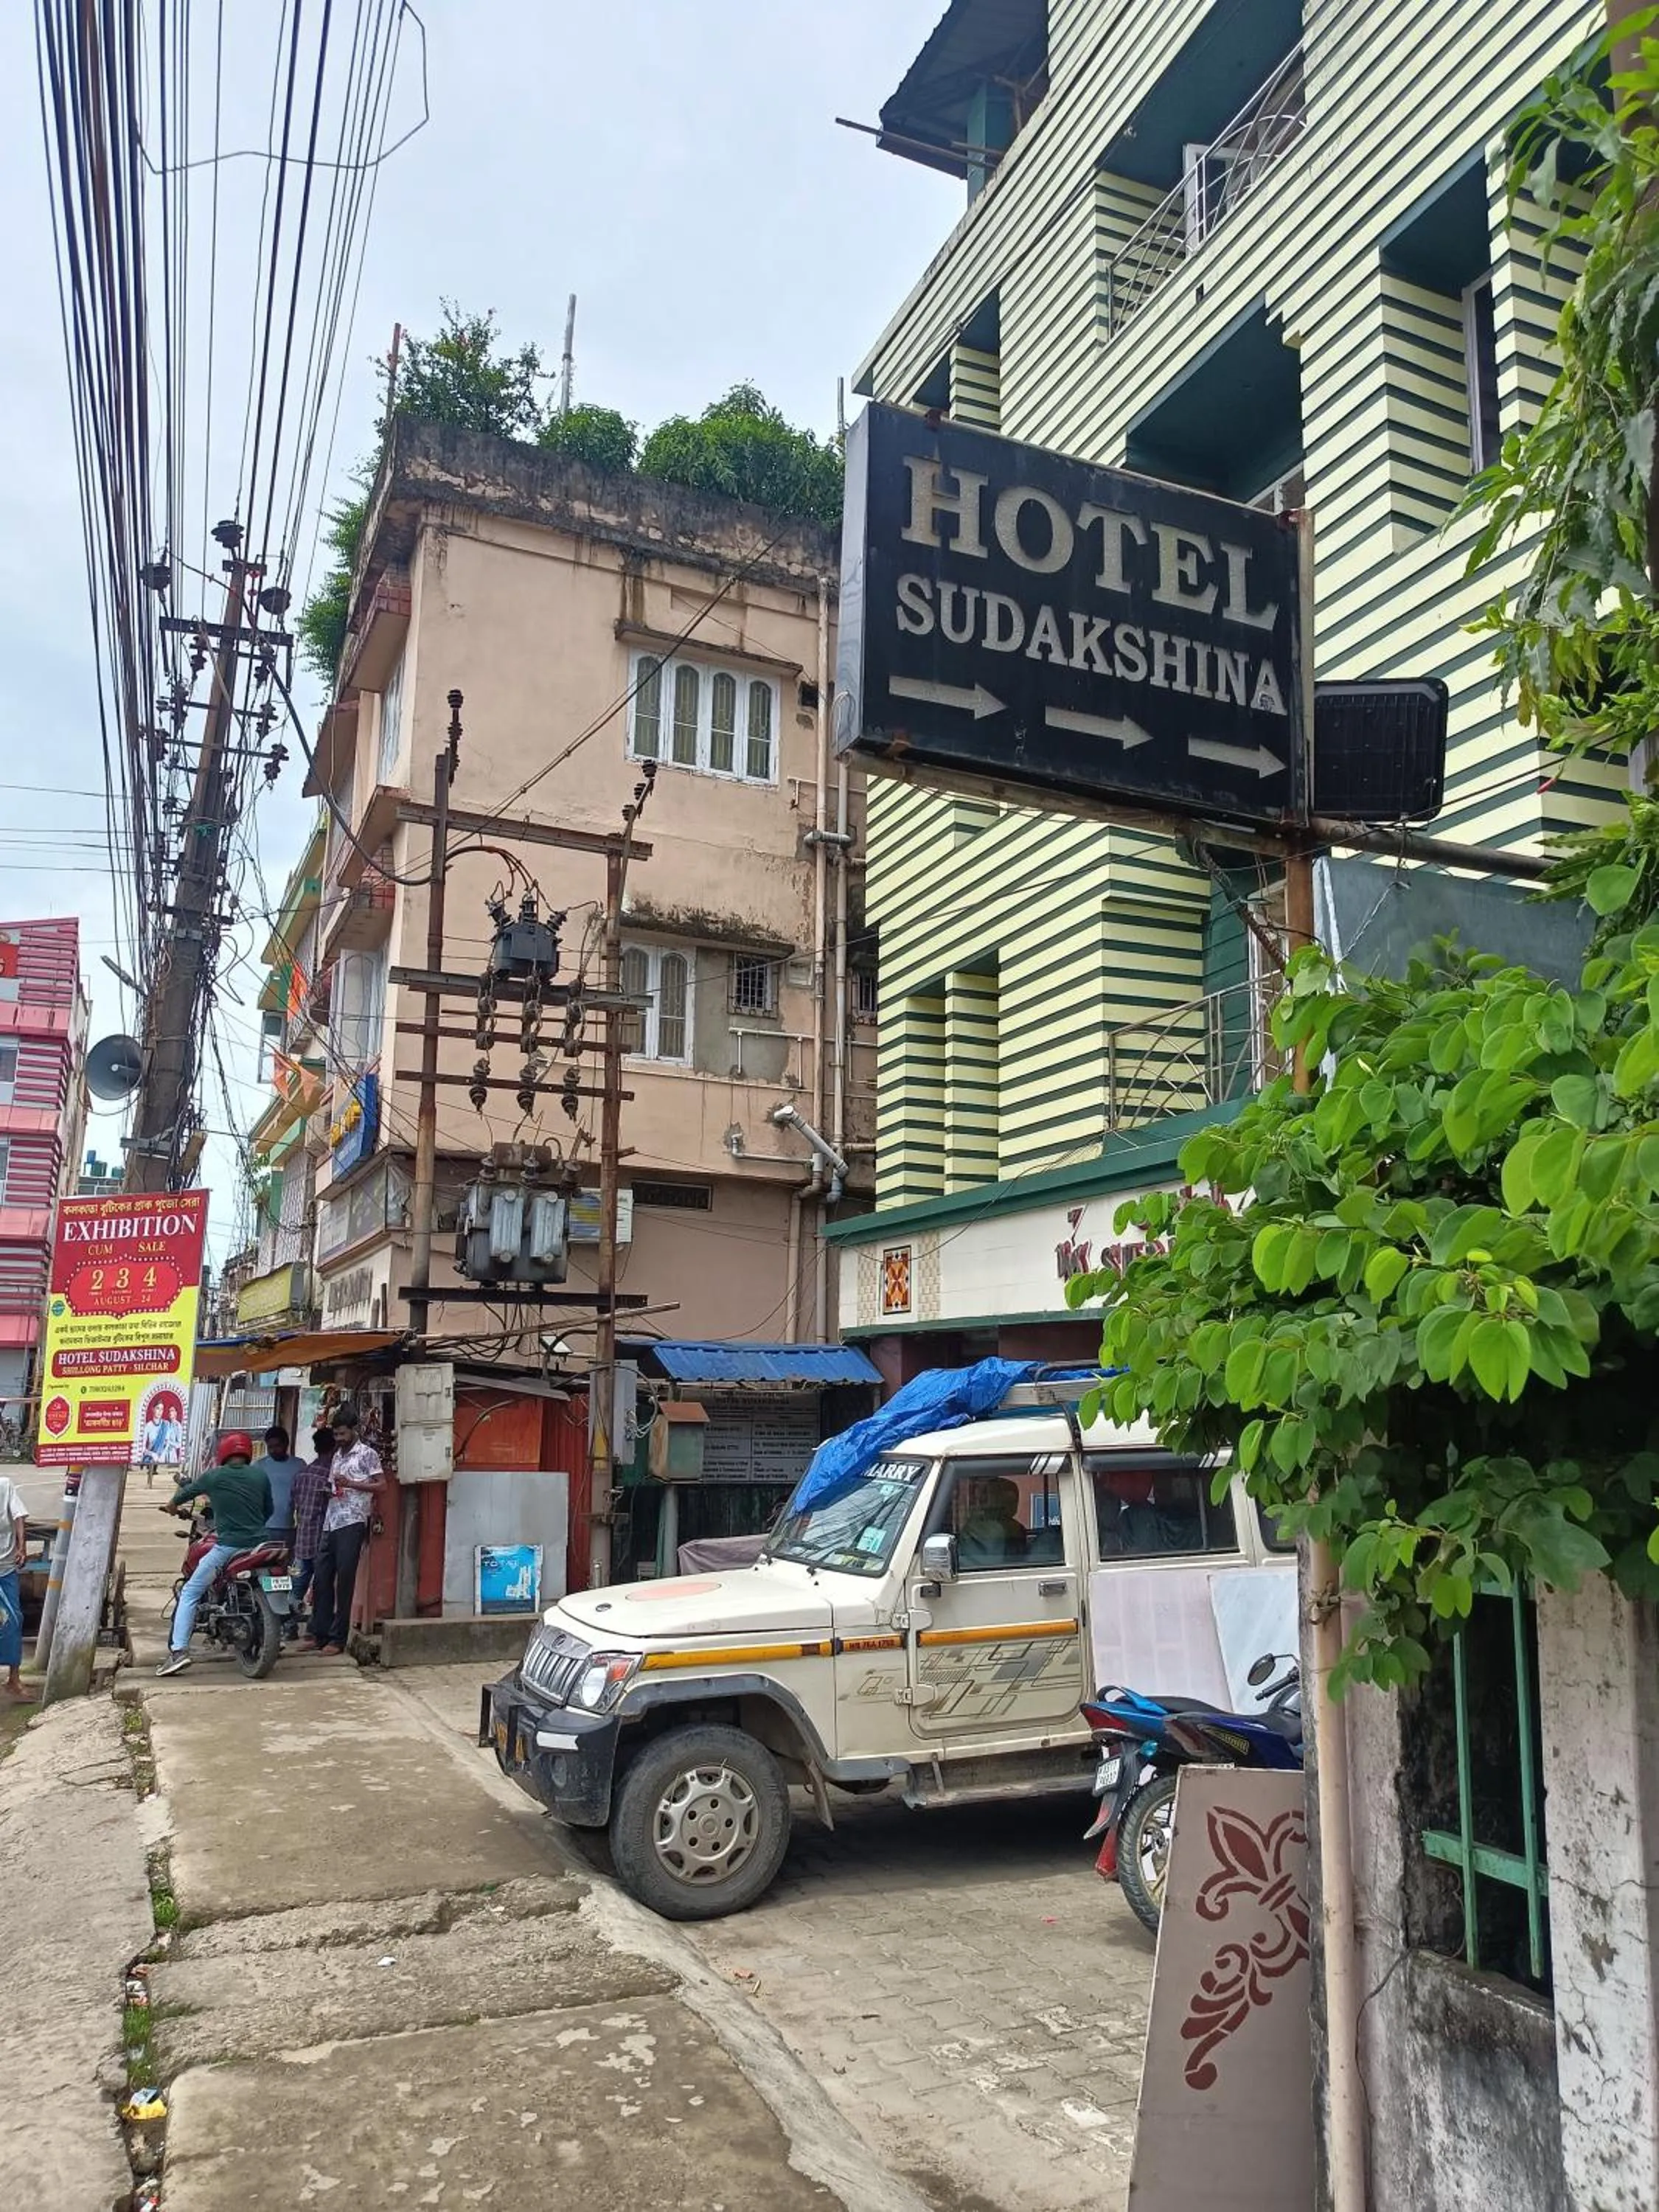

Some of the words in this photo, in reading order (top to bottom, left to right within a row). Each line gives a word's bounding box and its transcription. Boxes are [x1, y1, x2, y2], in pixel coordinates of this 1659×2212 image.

[901, 454, 1280, 633] HOTEL
[895, 572, 1287, 716] SUDAKSHINA
[63, 1213, 198, 1242] EXHIBITION
[88, 1244, 114, 1255] CUM
[138, 1241, 166, 1253] SALE
[91, 1269, 104, 1290] 2
[116, 1267, 129, 1288] 3
[143, 1266, 157, 1287] 4
[94, 1295, 131, 1306] AUGUST
[58, 1352, 97, 1365] HOTEL
[98, 1348, 175, 1363] SUDAKSHINA
[62, 1365, 101, 1375] SHILLONG
[133, 1362, 169, 1371] SILCHAR
